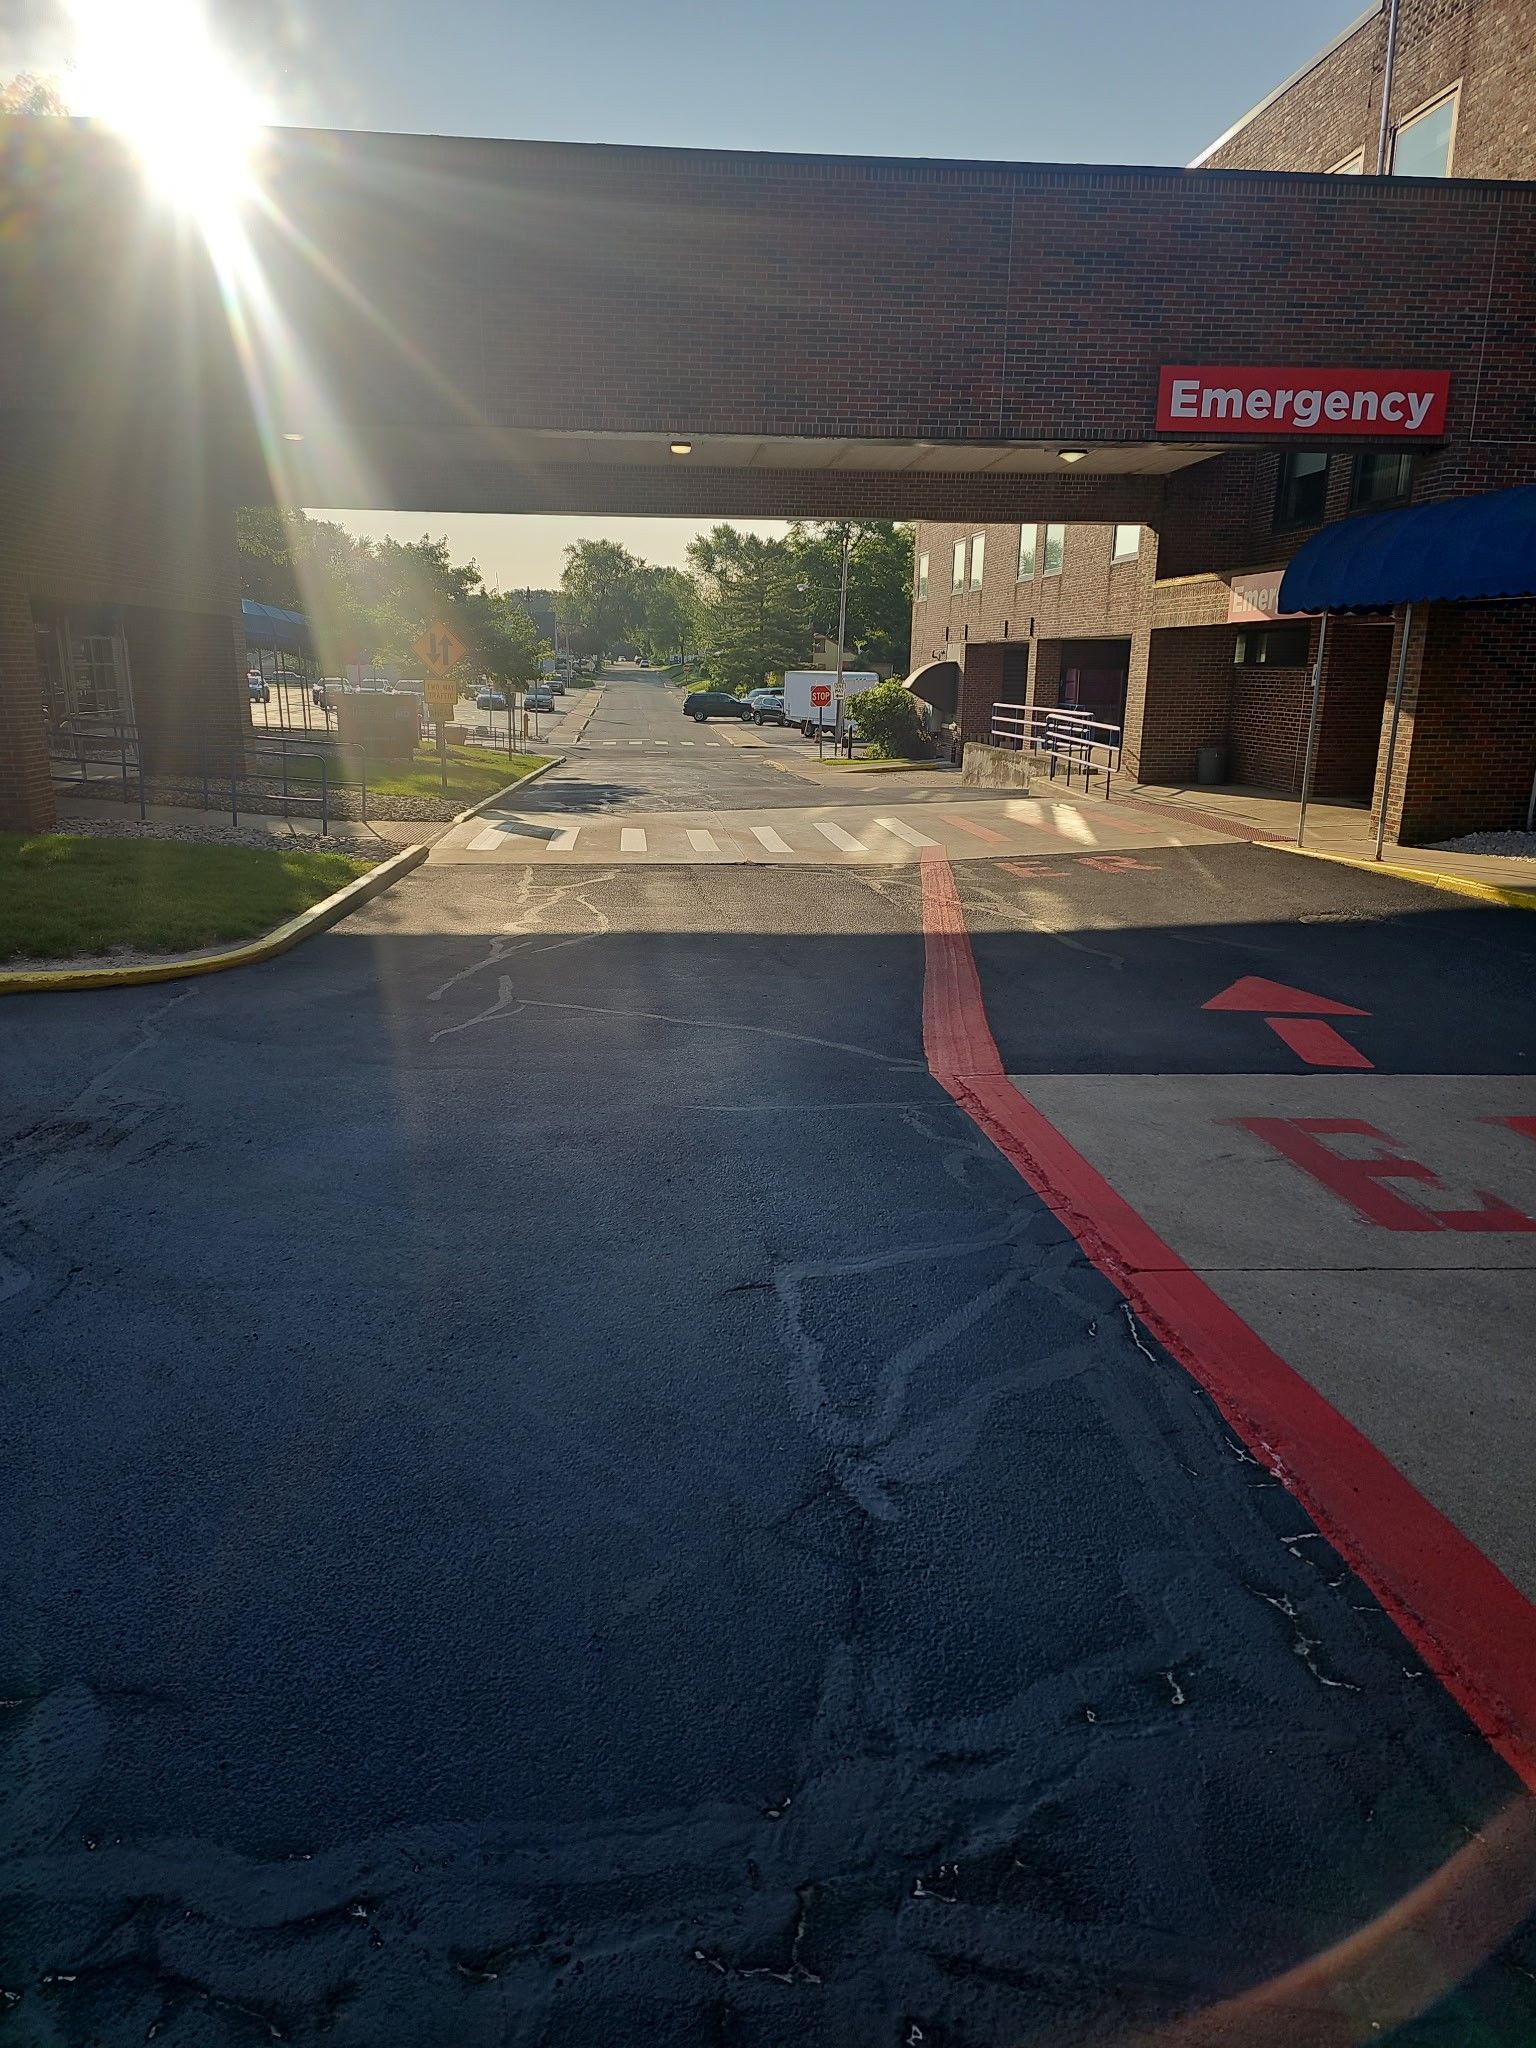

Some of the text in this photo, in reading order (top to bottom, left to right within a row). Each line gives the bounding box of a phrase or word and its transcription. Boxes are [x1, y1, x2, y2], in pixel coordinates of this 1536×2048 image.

[1170, 379, 1435, 430] Emergency
[812, 691, 830, 701] STOP
[1210, 1116, 1536, 1232] E
